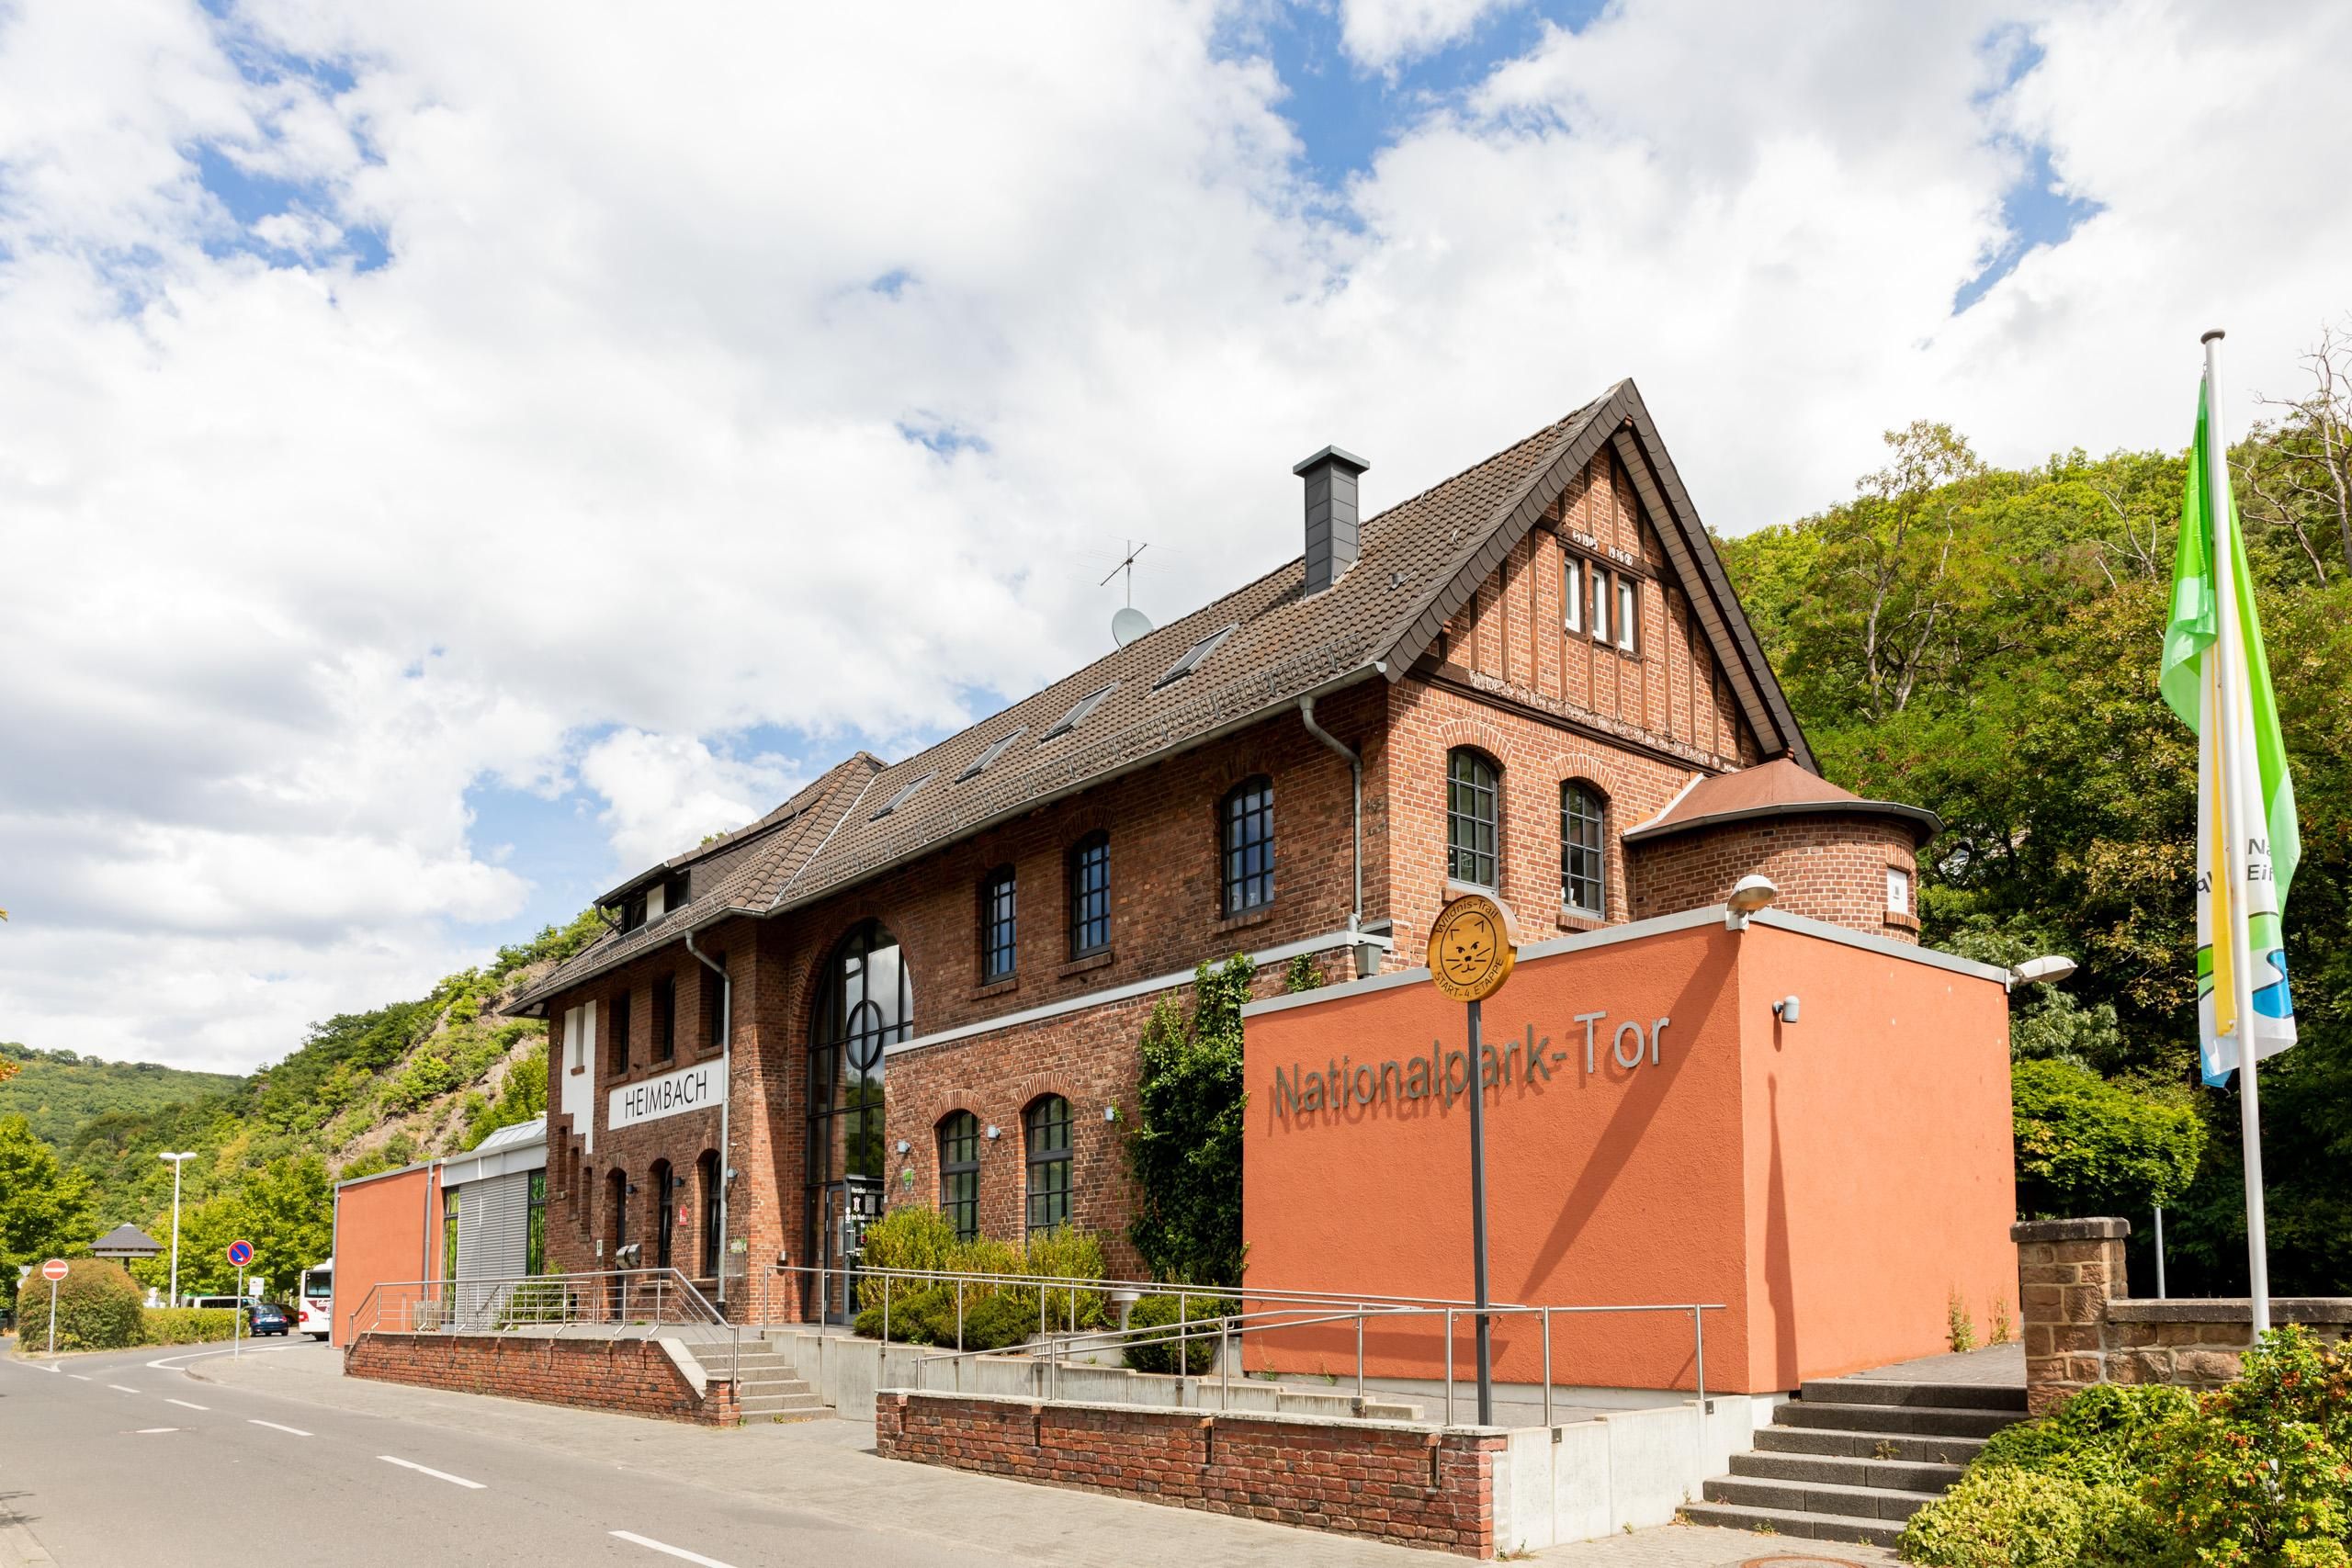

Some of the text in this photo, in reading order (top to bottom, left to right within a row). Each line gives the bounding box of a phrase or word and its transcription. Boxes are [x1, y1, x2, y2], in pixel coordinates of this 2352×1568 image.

[1435, 898, 1499, 935] Wildnis-Trail
[1474, 957, 1505, 996] ETAPPE
[1276, 1010, 1670, 1117] Nationalpark-Tor
[625, 1069, 707, 1119] HEIMBACH
